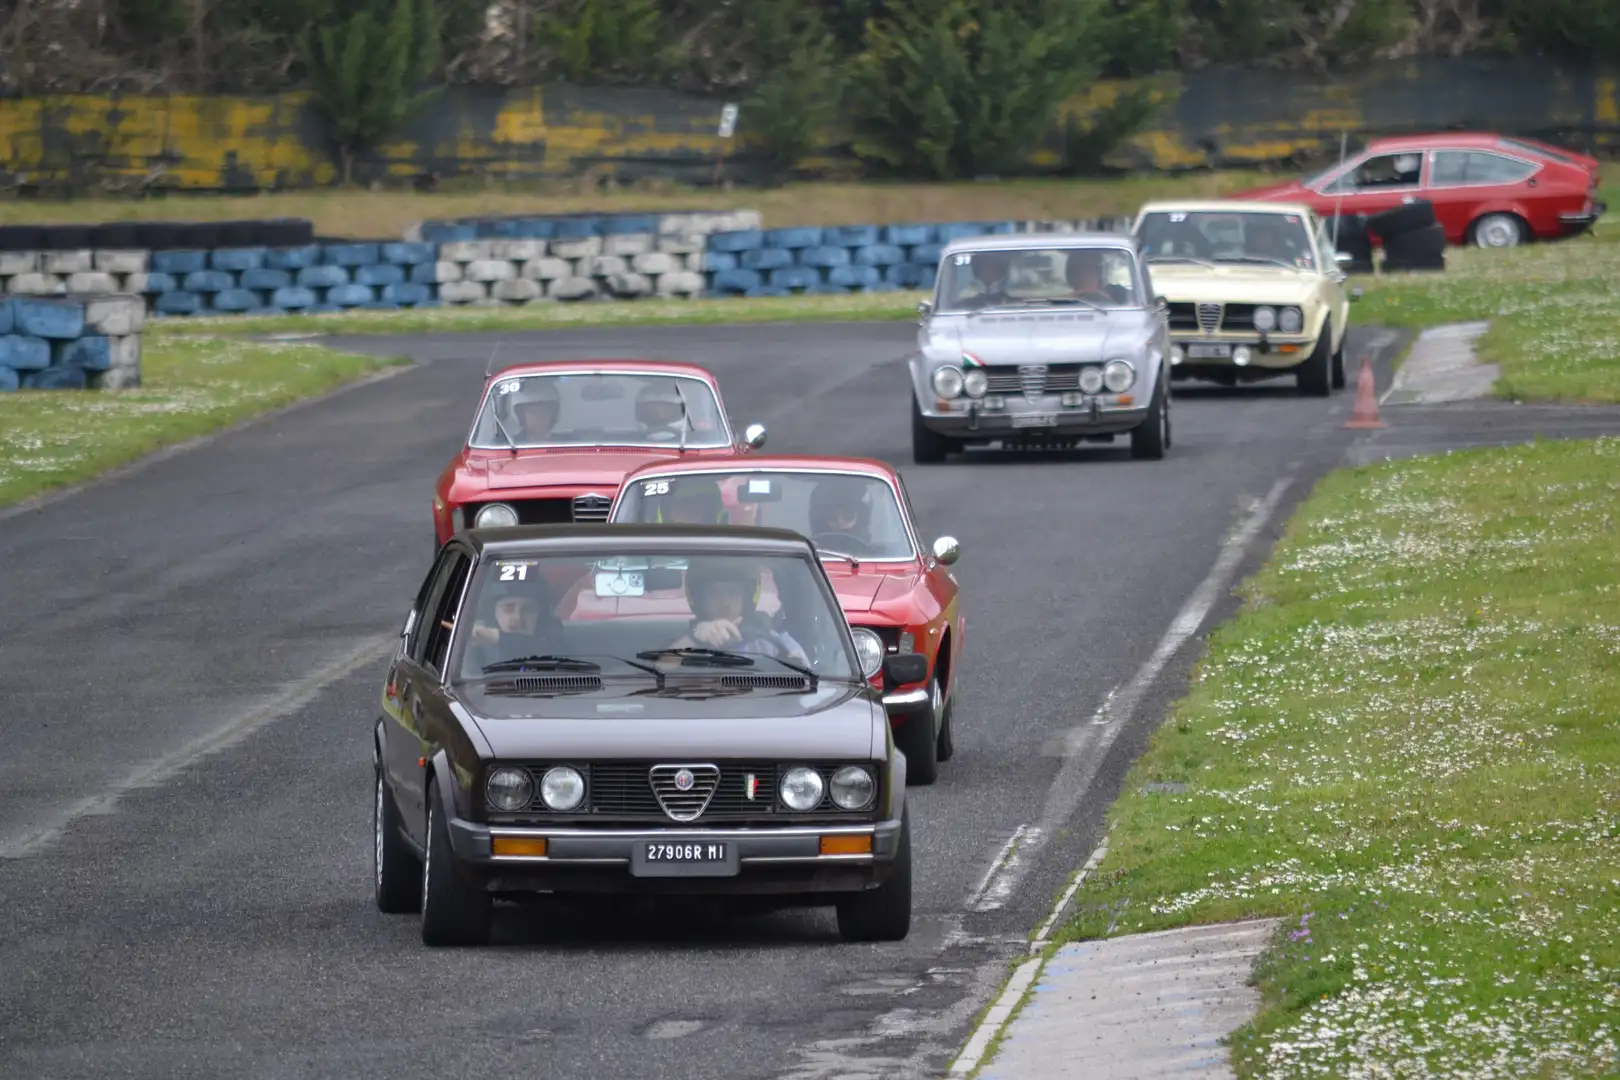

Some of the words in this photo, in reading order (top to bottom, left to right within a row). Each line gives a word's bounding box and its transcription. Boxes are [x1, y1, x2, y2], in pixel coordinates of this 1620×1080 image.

[499, 382, 520, 395] 30
[644, 482, 670, 496] 25
[500, 565, 527, 581] 21
[648, 844, 702, 860] 27906R
[708, 844, 723, 860] MI
